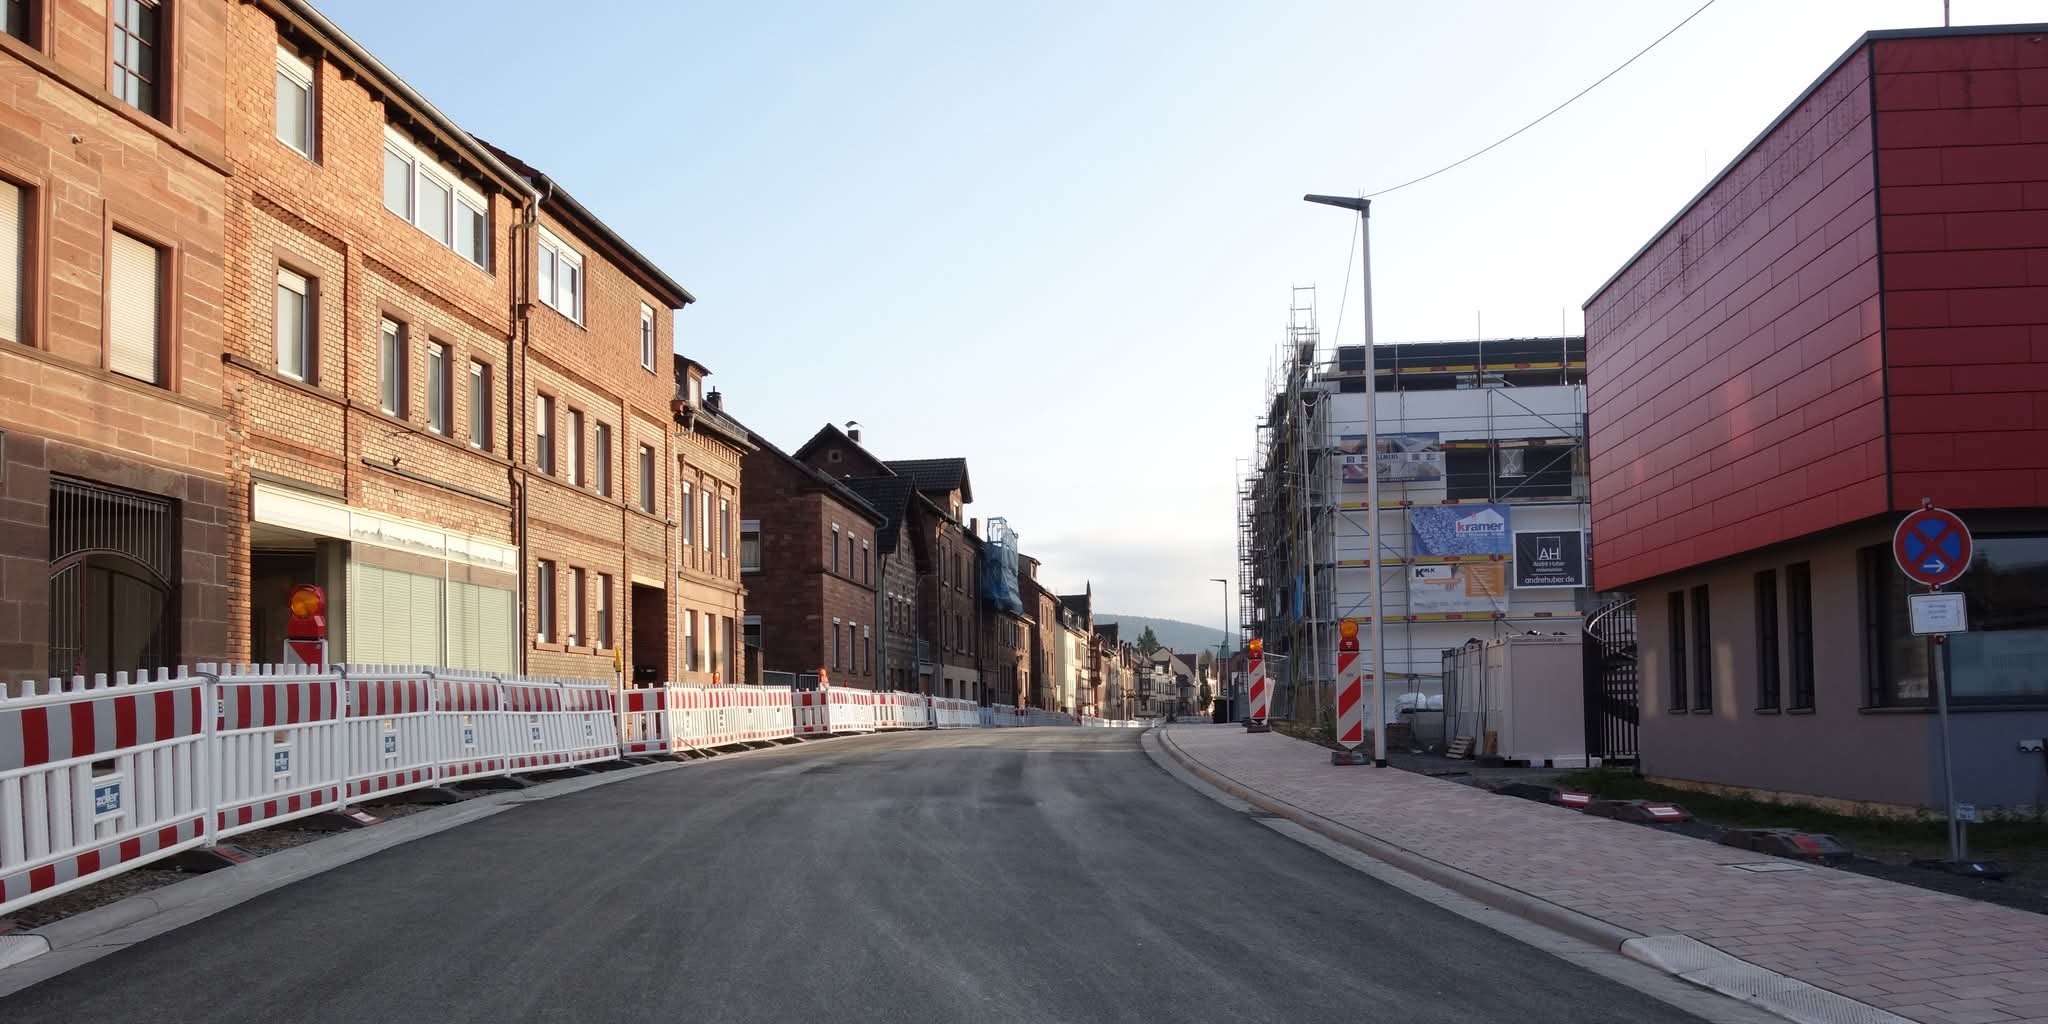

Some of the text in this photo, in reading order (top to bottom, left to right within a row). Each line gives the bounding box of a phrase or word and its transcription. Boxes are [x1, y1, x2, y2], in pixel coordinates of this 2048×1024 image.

[1457, 522, 1503, 532] kramer
[1539, 547, 1560, 560] AH
[1524, 575, 1575, 584] andrehuber.de
